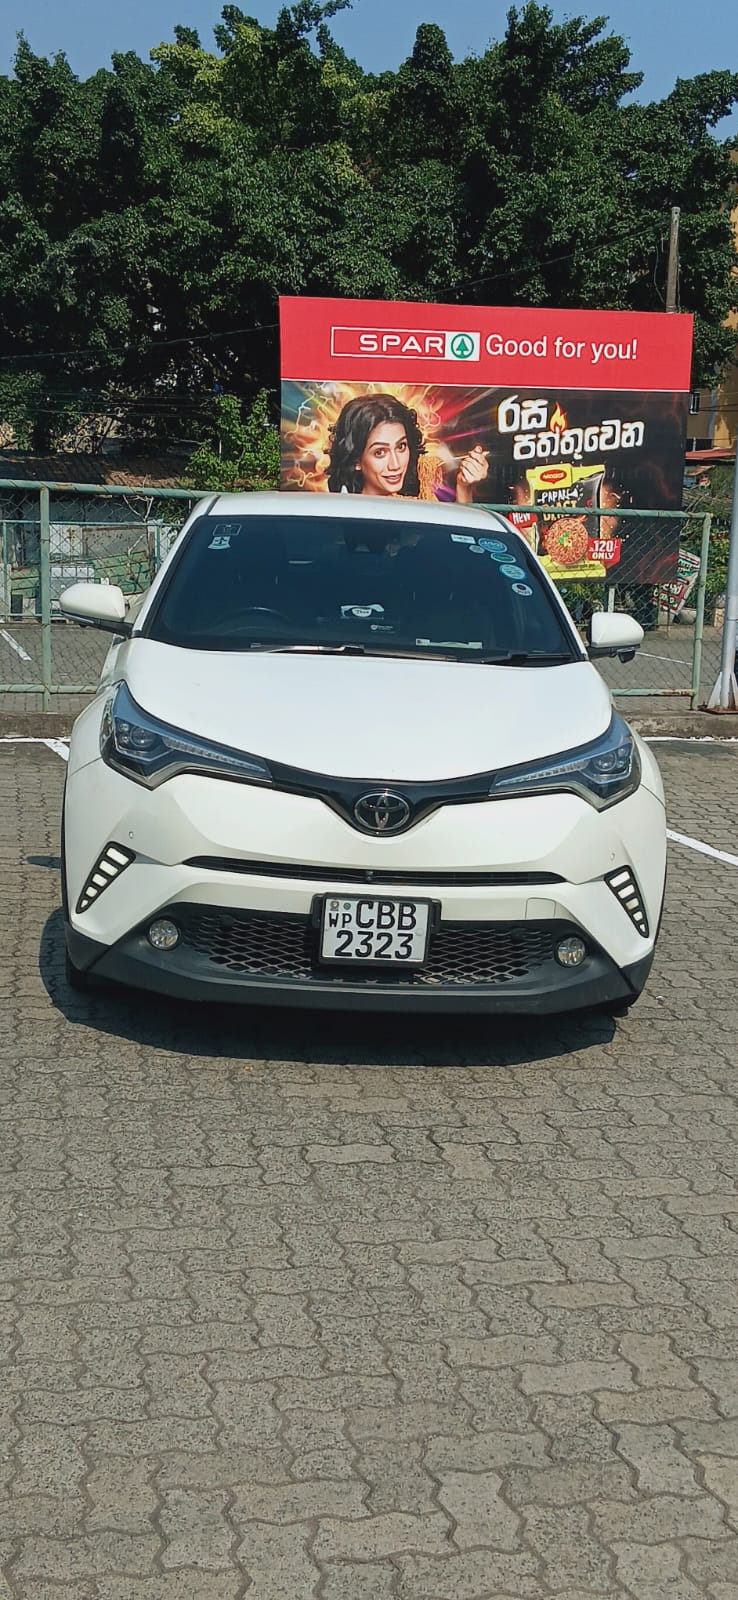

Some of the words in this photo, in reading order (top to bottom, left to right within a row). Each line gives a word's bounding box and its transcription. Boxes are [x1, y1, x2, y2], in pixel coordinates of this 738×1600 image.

[359, 334, 443, 353] SPAR
[486, 334, 547, 357] Good
[554, 336, 585, 359] for
[591, 339, 637, 364] you!
[498, 394, 548, 433] රස
[592, 551, 615, 560] ONLY
[328, 912, 352, 928] WP
[355, 900, 417, 930] CBB
[334, 930, 414, 959] 2323
